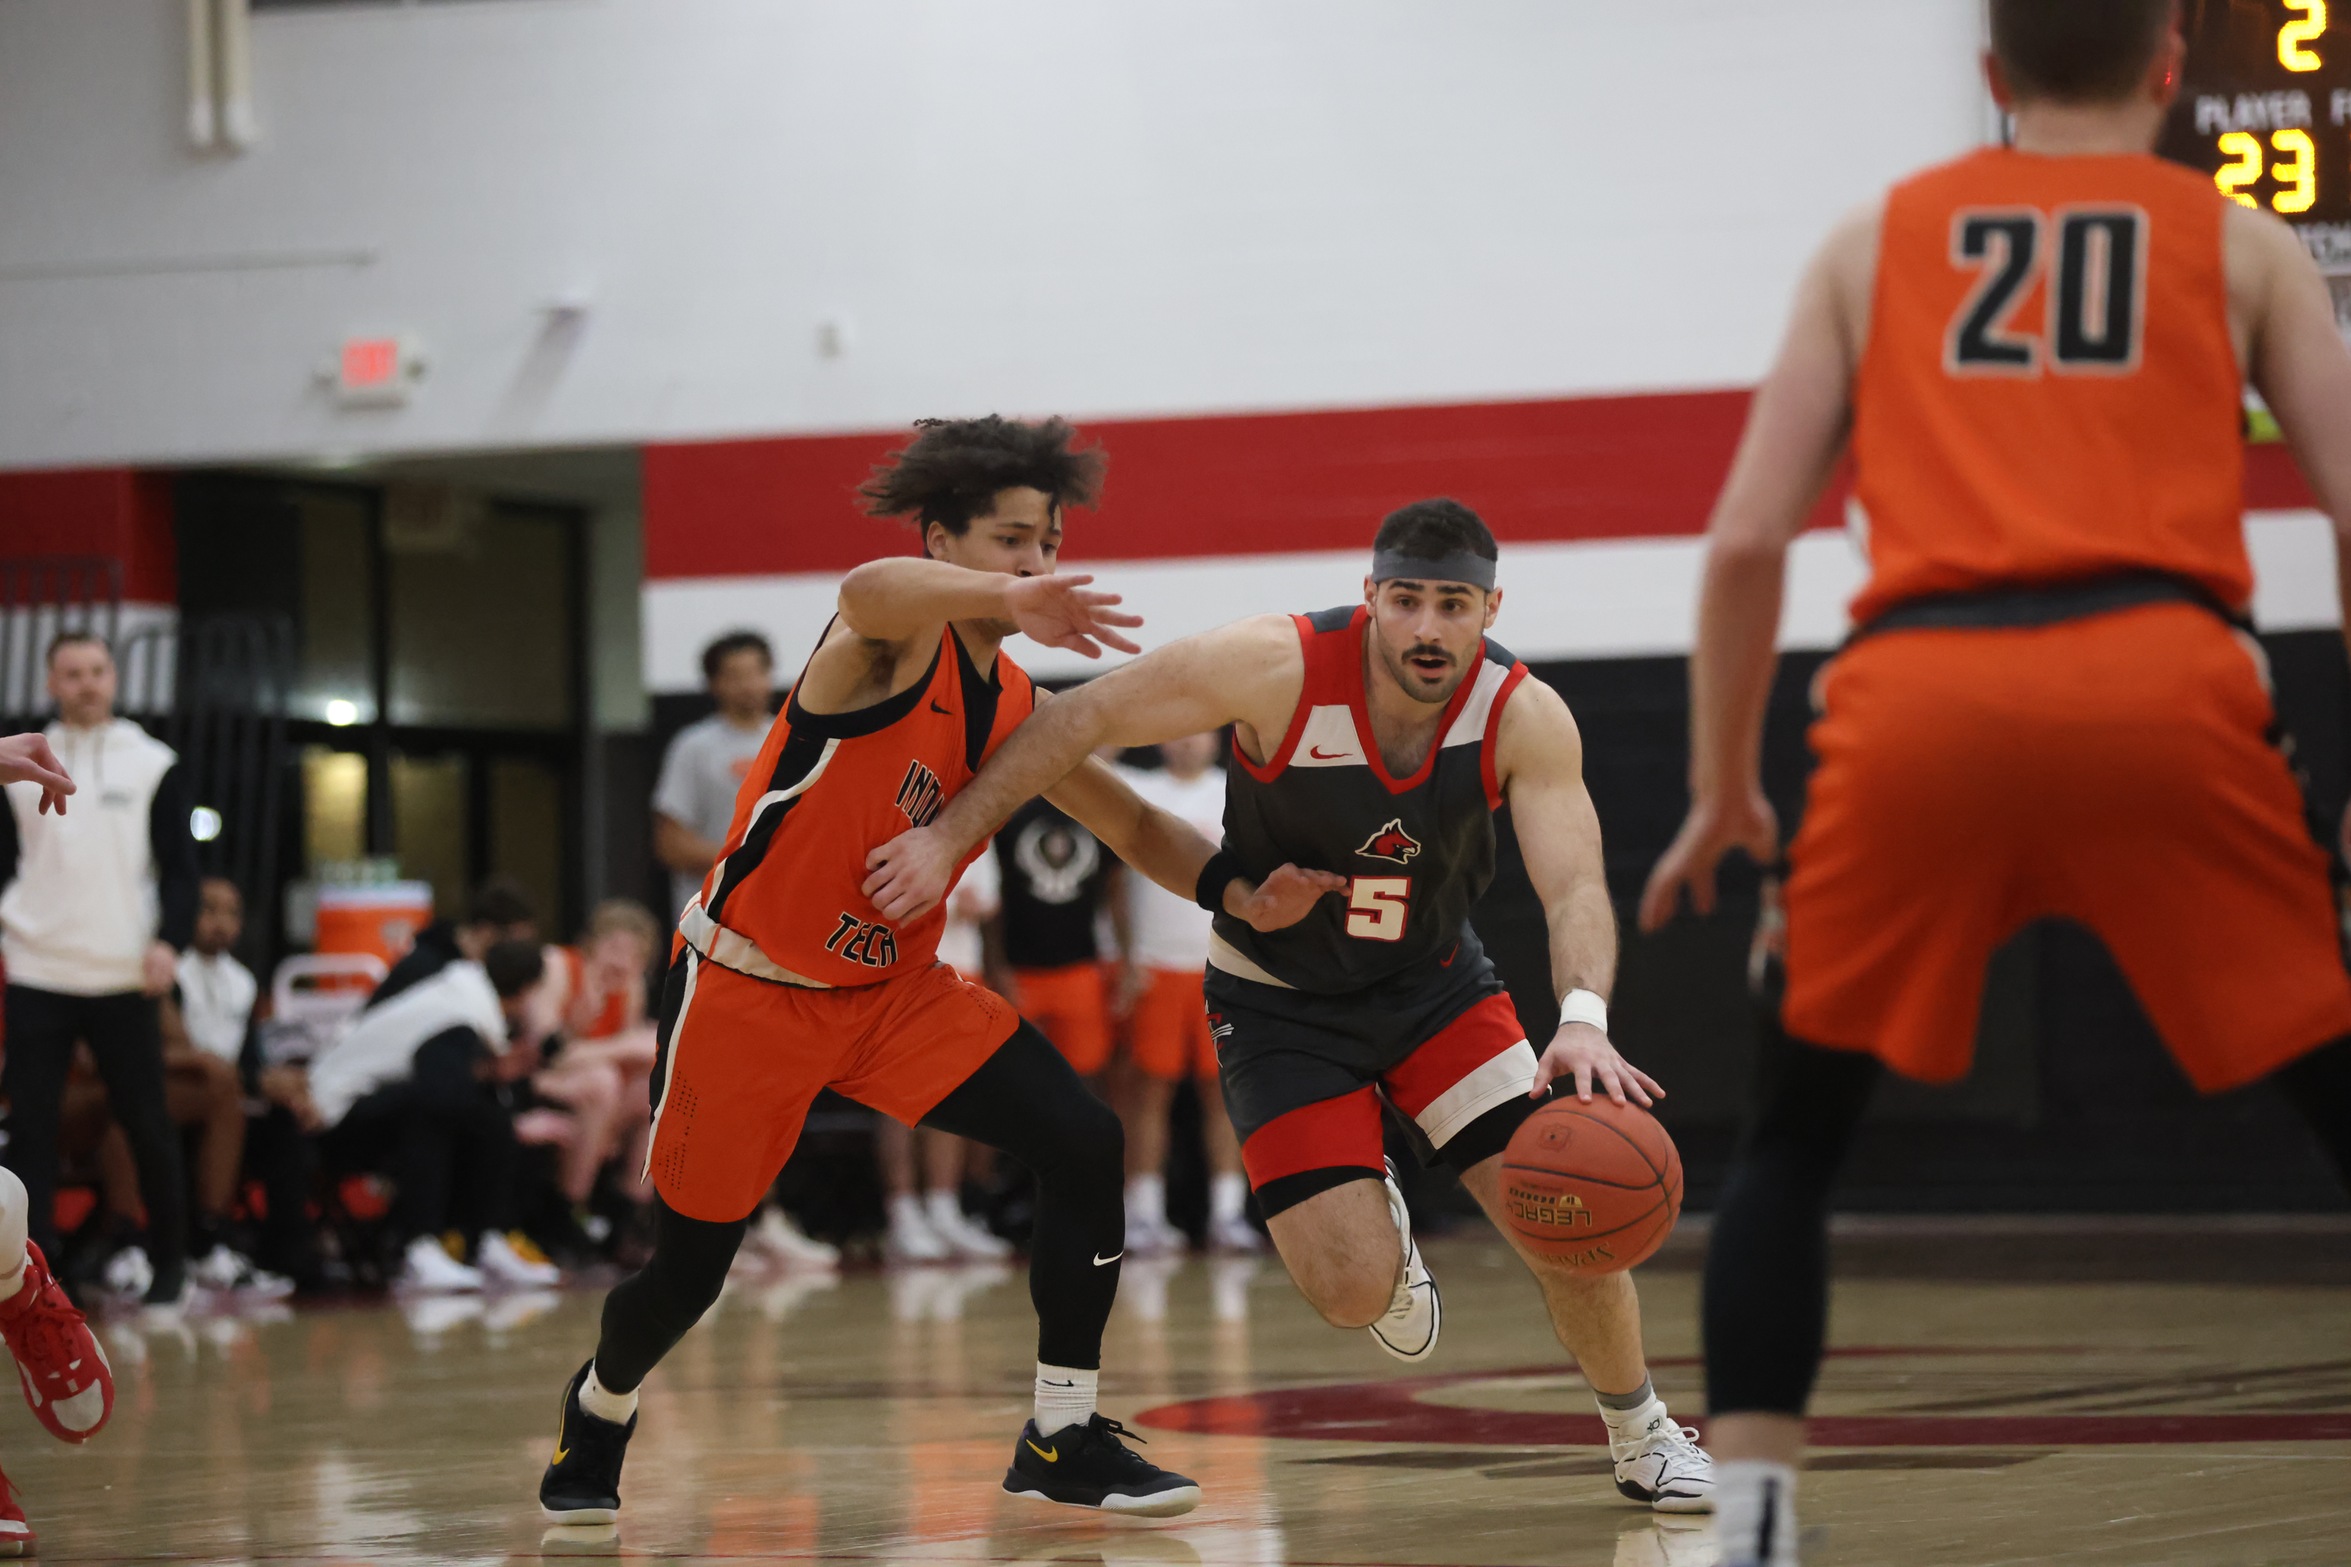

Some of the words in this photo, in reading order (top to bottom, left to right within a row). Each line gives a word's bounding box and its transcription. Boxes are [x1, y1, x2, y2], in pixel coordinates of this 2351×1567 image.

[2277, 0, 2327, 72] 2
[2195, 88, 2312, 135] PLAYER
[2214, 128, 2316, 213] 23
[1942, 201, 2150, 380] 20
[825, 911, 898, 968] TECH
[1344, 875, 1412, 943] 5
[1505, 1199, 1592, 1227] LEGACY
